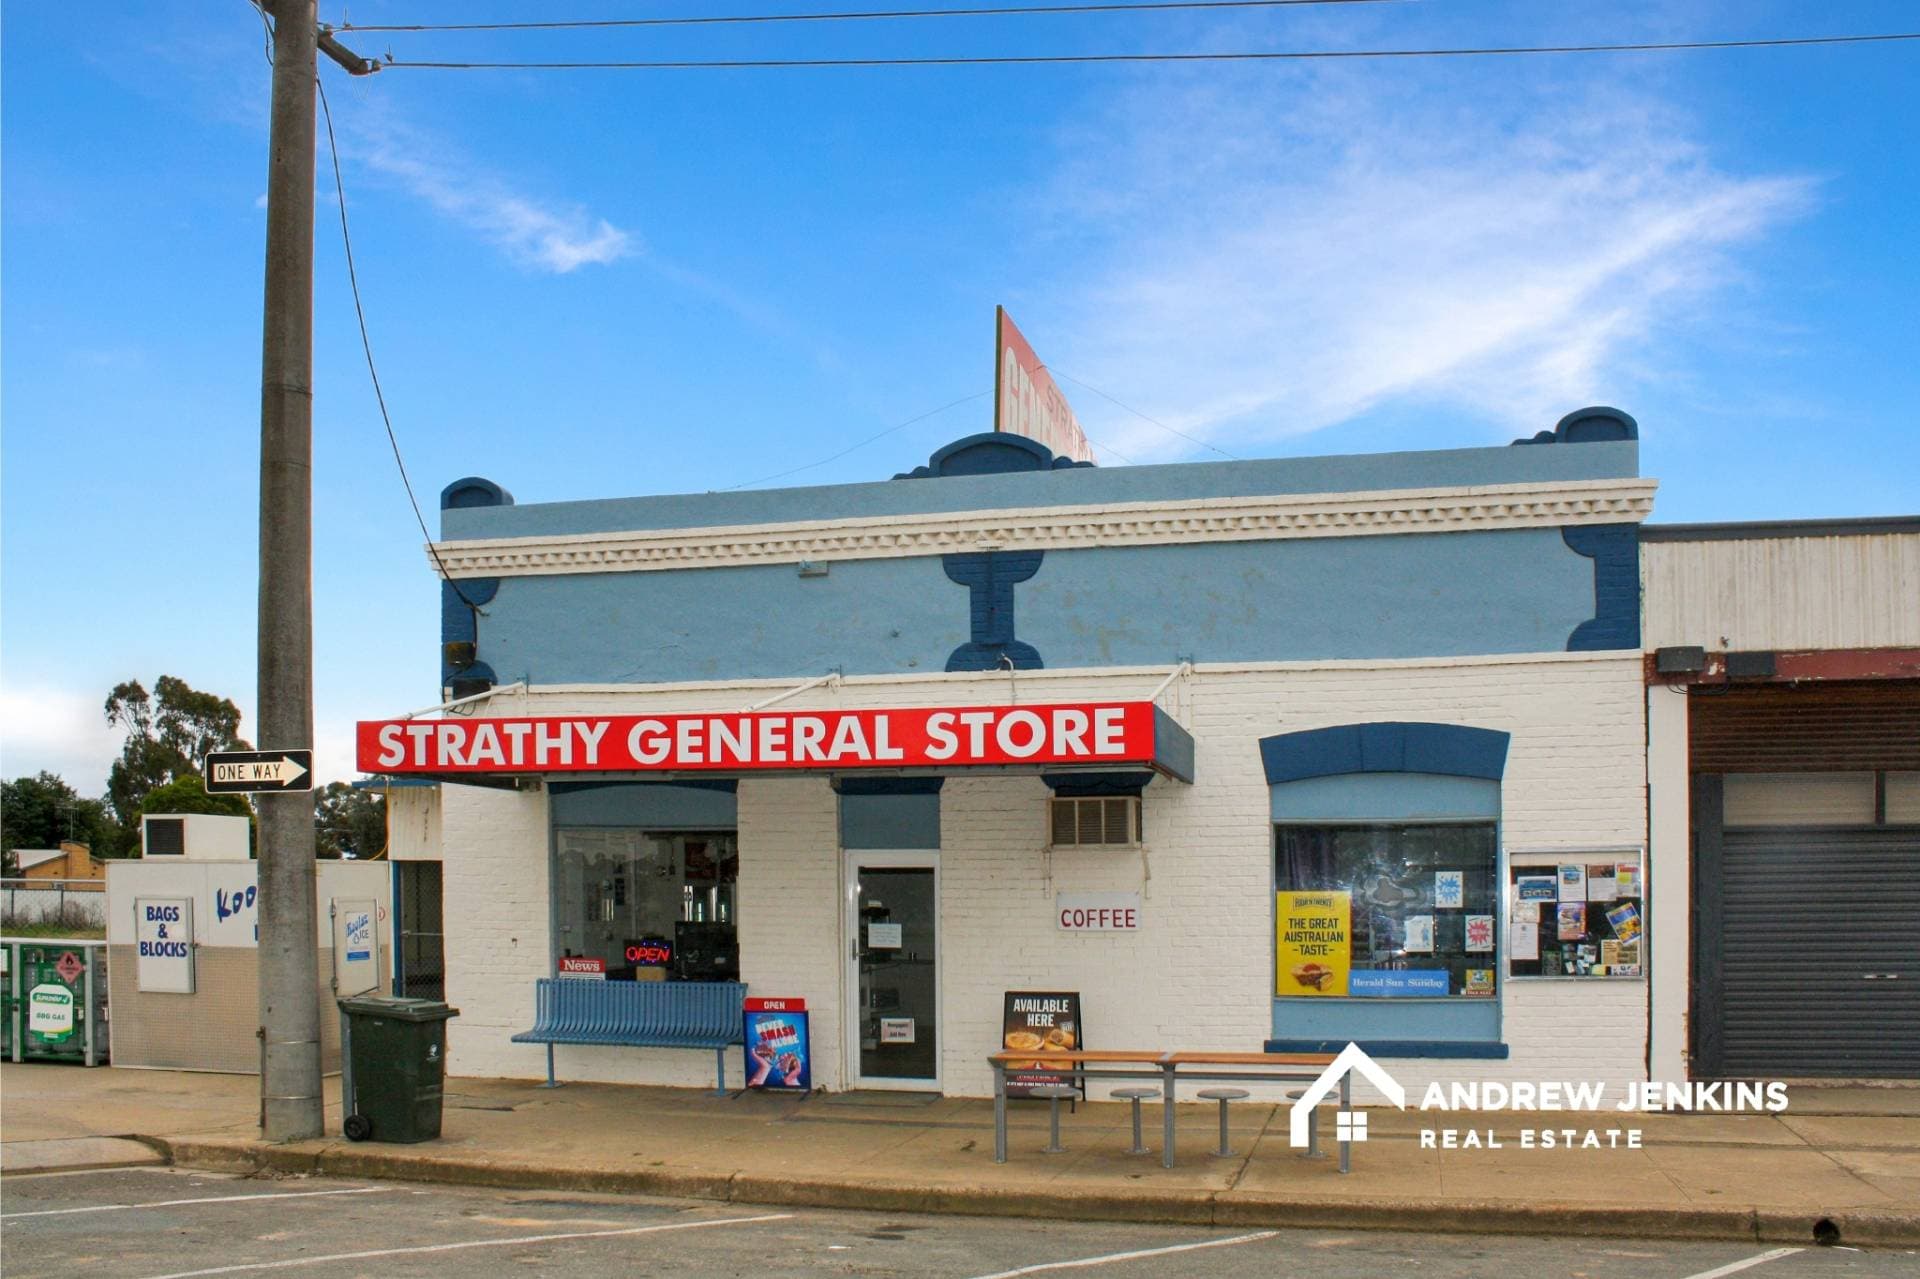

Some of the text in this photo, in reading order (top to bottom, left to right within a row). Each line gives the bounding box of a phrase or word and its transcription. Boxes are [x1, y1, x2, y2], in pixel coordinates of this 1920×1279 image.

[378, 707, 1125, 767] STRATHY GENERAL STORE
[217, 764, 281, 780] ONE WAY
[146, 906, 180, 921] BAGS
[1060, 908, 1137, 928] COFFEE
[158, 923, 168, 939] &
[1288, 918, 1339, 929] THE GREAT
[1283, 931, 1344, 943] AUSTRALIAN
[140, 941, 188, 957] BLOCKS
[625, 945, 670, 962] OPEN
[1299, 944, 1328, 956] TASTE
[563, 959, 601, 972] News
[1352, 977, 1445, 988] Herald Sun Sunday
[763, 1000, 786, 1010] OPEN
[1013, 998, 1069, 1013] AVAILABLE
[52, 1013, 66, 1021] GAS
[1026, 1013, 1054, 1027] HERE
[761, 1024, 796, 1041] SMASH
